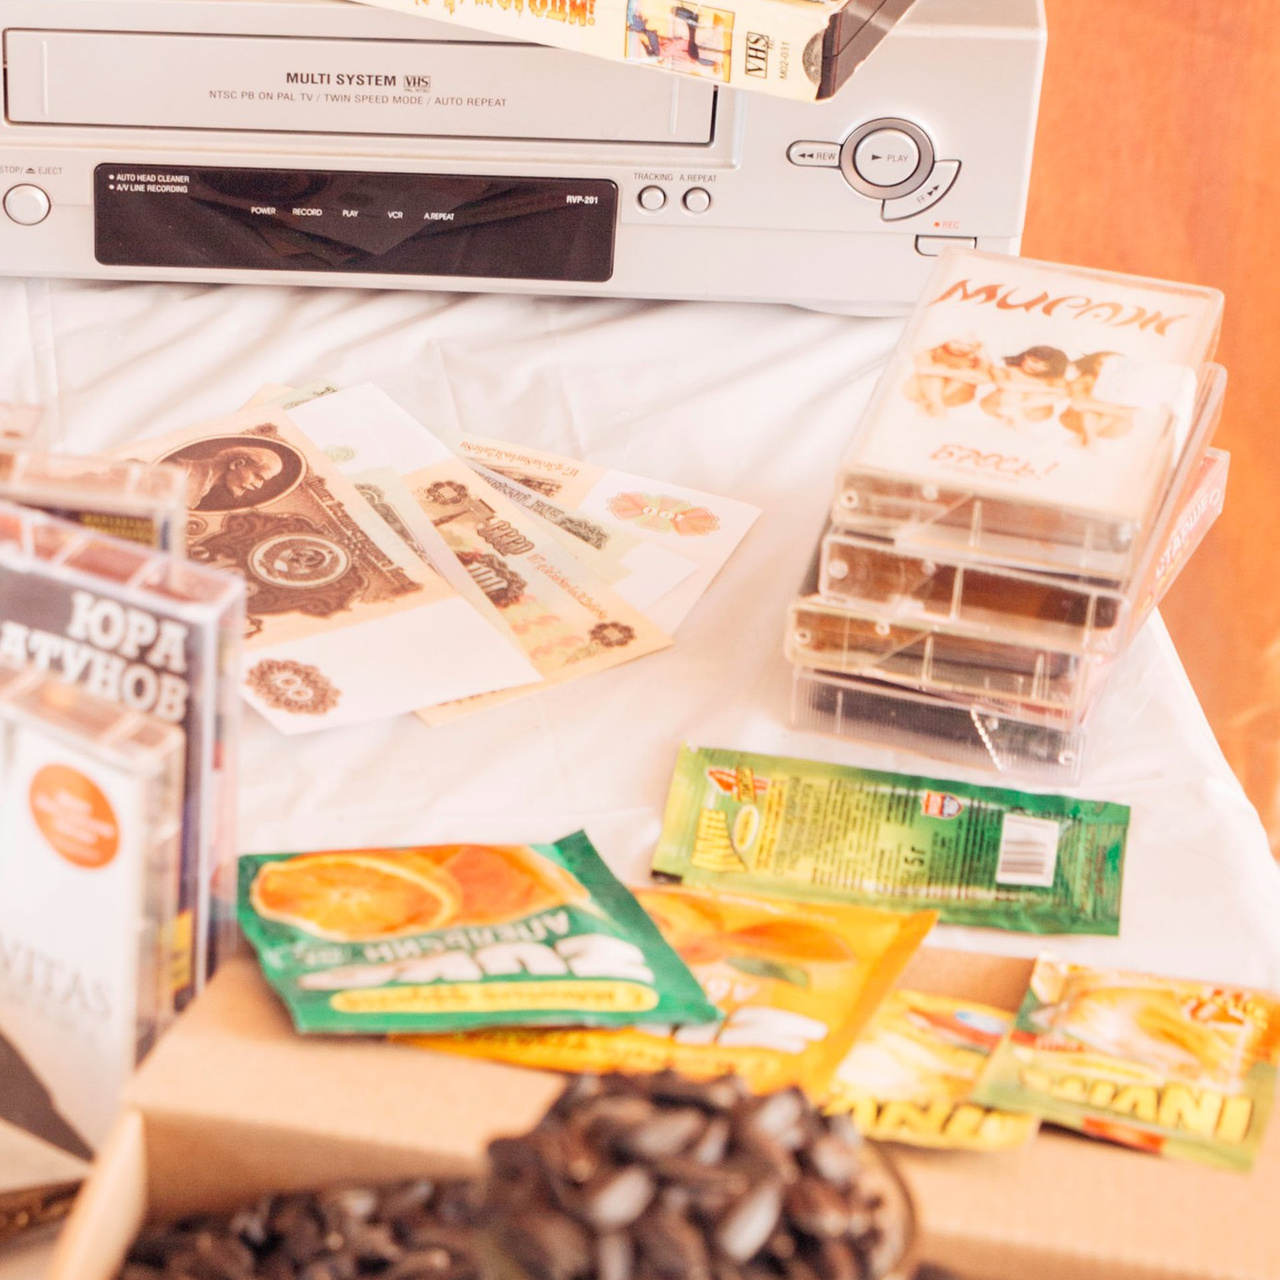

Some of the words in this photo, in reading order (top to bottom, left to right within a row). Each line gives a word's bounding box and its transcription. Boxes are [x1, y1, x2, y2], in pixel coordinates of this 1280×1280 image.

[747, 33, 769, 78] VHS
[286, 72, 331, 85] MULTI
[336, 73, 397, 87] SYSTEM
[404, 75, 431, 88] VHS
[209, 90, 238, 100] NTSC
[241, 91, 255, 101] PB
[258, 91, 274, 101] ON
[277, 92, 296, 102] PAL
[299, 93, 314, 102] TV
[324, 93, 351, 103] TWIN
[354, 94, 389, 104] SPEED
[392, 95, 423, 106] MODE
[434, 96, 463, 106] AUTO
[466, 98, 507, 108] REPEAT
[817, 151, 837, 161] REW
[887, 153, 909, 164] PLAY
[38, 166, 63, 175] EJECT
[116, 174, 136, 183] AUTO
[137, 175, 156, 183] HEAD
[157, 175, 190, 184] CLEANER
[634, 172, 674, 182] TRACKING
[116, 184, 129, 192] A/V
[130, 184, 146, 193] LINE
[147, 185, 189, 194] RECORDING
[566, 195, 599, 205] RVP-201
[250, 206, 277, 215] POWER
[292, 207, 323, 217] RECORD
[342, 209, 359, 218] PLAY
[387, 210, 404, 220] VCR
[942, 220, 960, 230] REC
[67, 592, 190, 675] ЮРА
